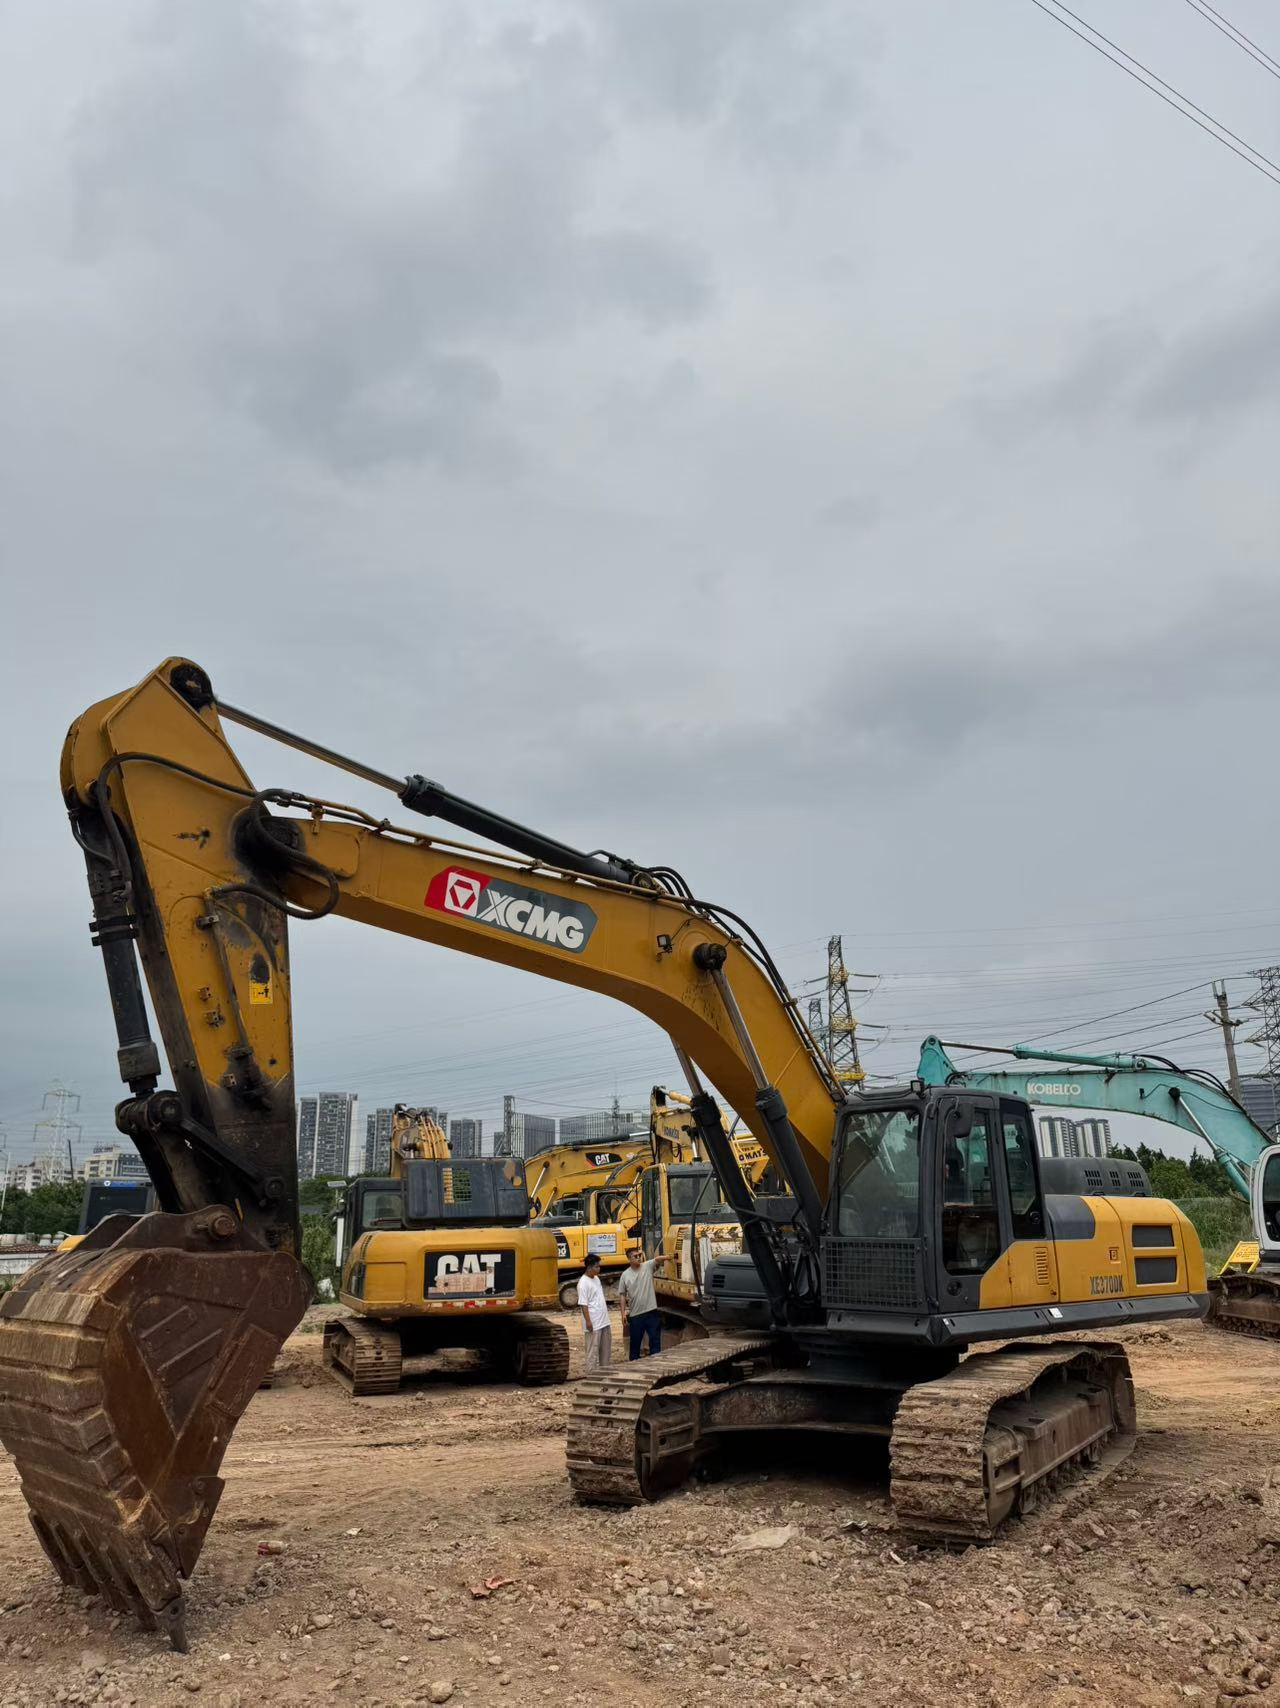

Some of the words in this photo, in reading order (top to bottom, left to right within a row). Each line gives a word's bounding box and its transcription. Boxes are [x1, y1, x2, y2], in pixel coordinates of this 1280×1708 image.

[476, 889, 584, 949] XCMG
[1027, 1082, 1081, 1095] KOBELCO
[595, 1153, 610, 1165] CAT
[739, 1148, 767, 1161] OMATS
[437, 1254, 501, 1288] CAT
